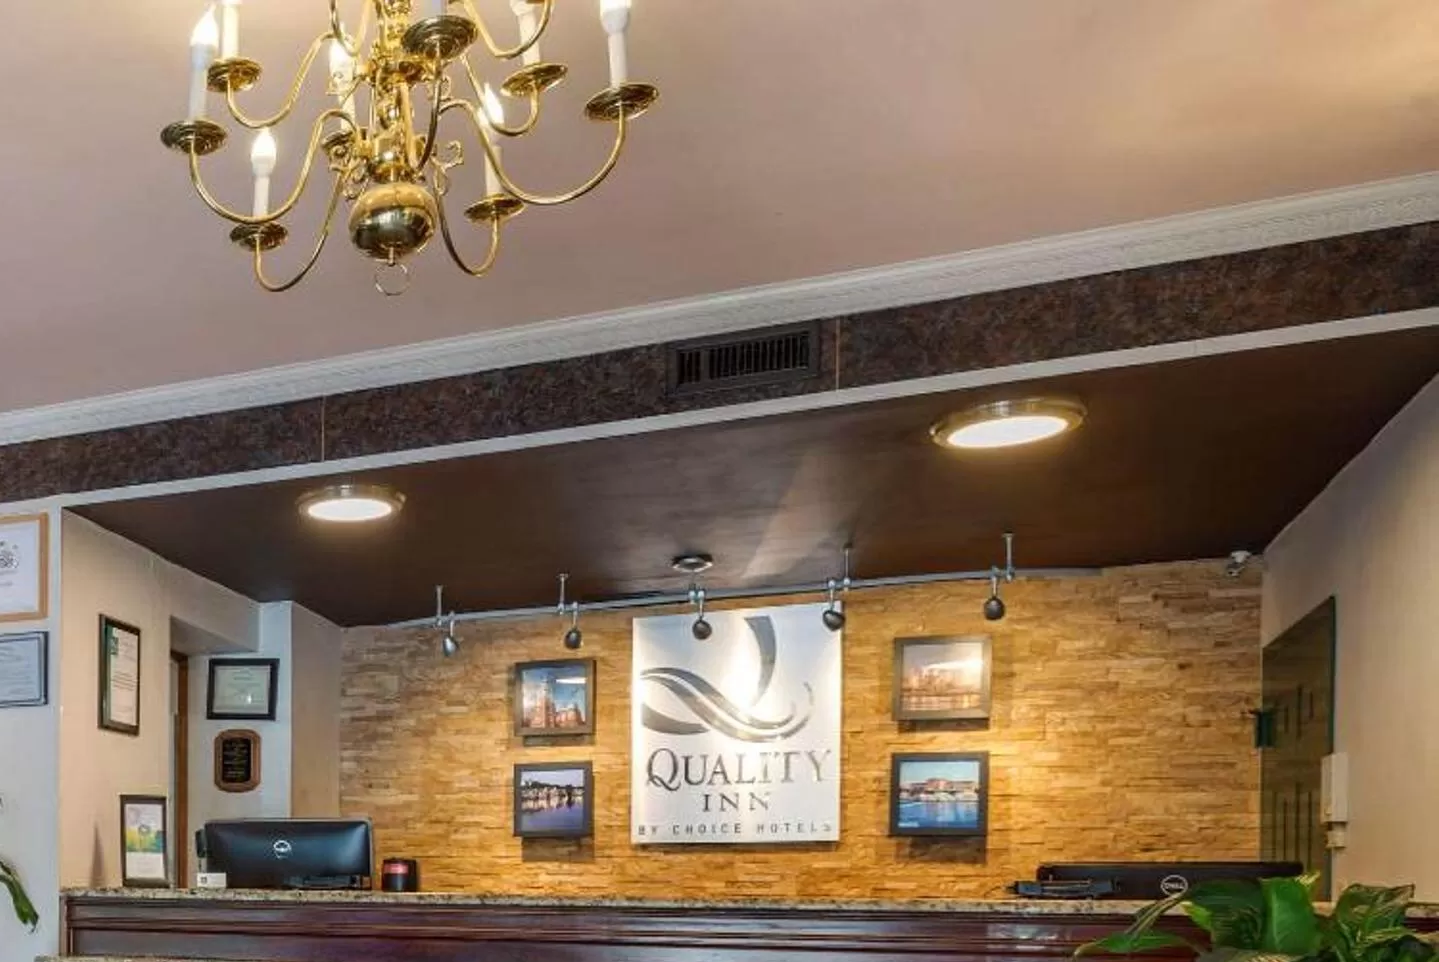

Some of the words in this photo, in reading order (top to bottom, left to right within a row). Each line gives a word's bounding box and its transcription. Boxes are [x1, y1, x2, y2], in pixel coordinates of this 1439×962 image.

[646, 748, 831, 791] QUALITY
[702, 792, 771, 813] INN
[638, 825, 658, 836] BY
[672, 823, 742, 835] CHOICE
[756, 822, 832, 834] HOTELS
